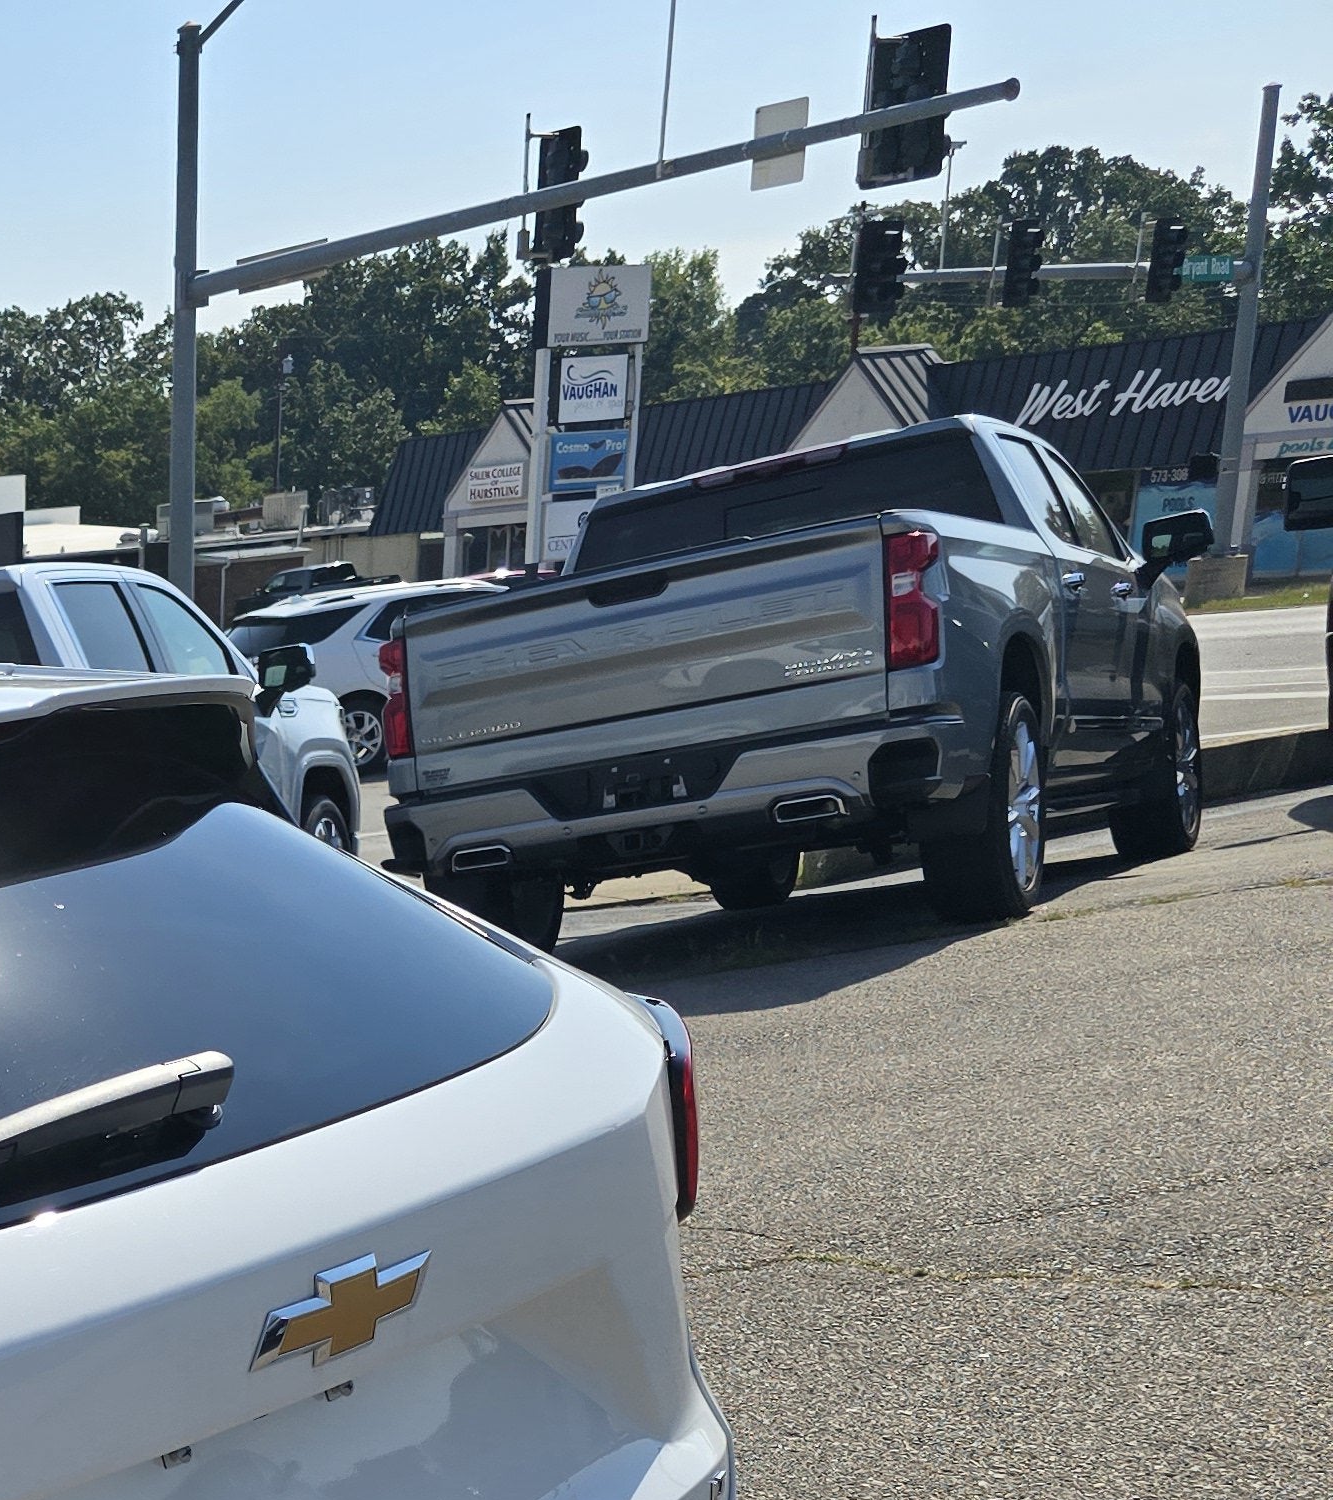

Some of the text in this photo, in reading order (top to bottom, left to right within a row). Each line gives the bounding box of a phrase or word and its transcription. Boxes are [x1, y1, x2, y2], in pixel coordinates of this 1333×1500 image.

[1211, 257, 1230, 275] Road
[562, 381, 618, 401] VAUGHAN
[1014, 379, 1112, 428] West
[1288, 403, 1333, 424] VAU
[556, 438, 627, 454] Cosmo Prof
[1277, 436, 1326, 458] pools
[491, 465, 522, 479] COLLEGE
